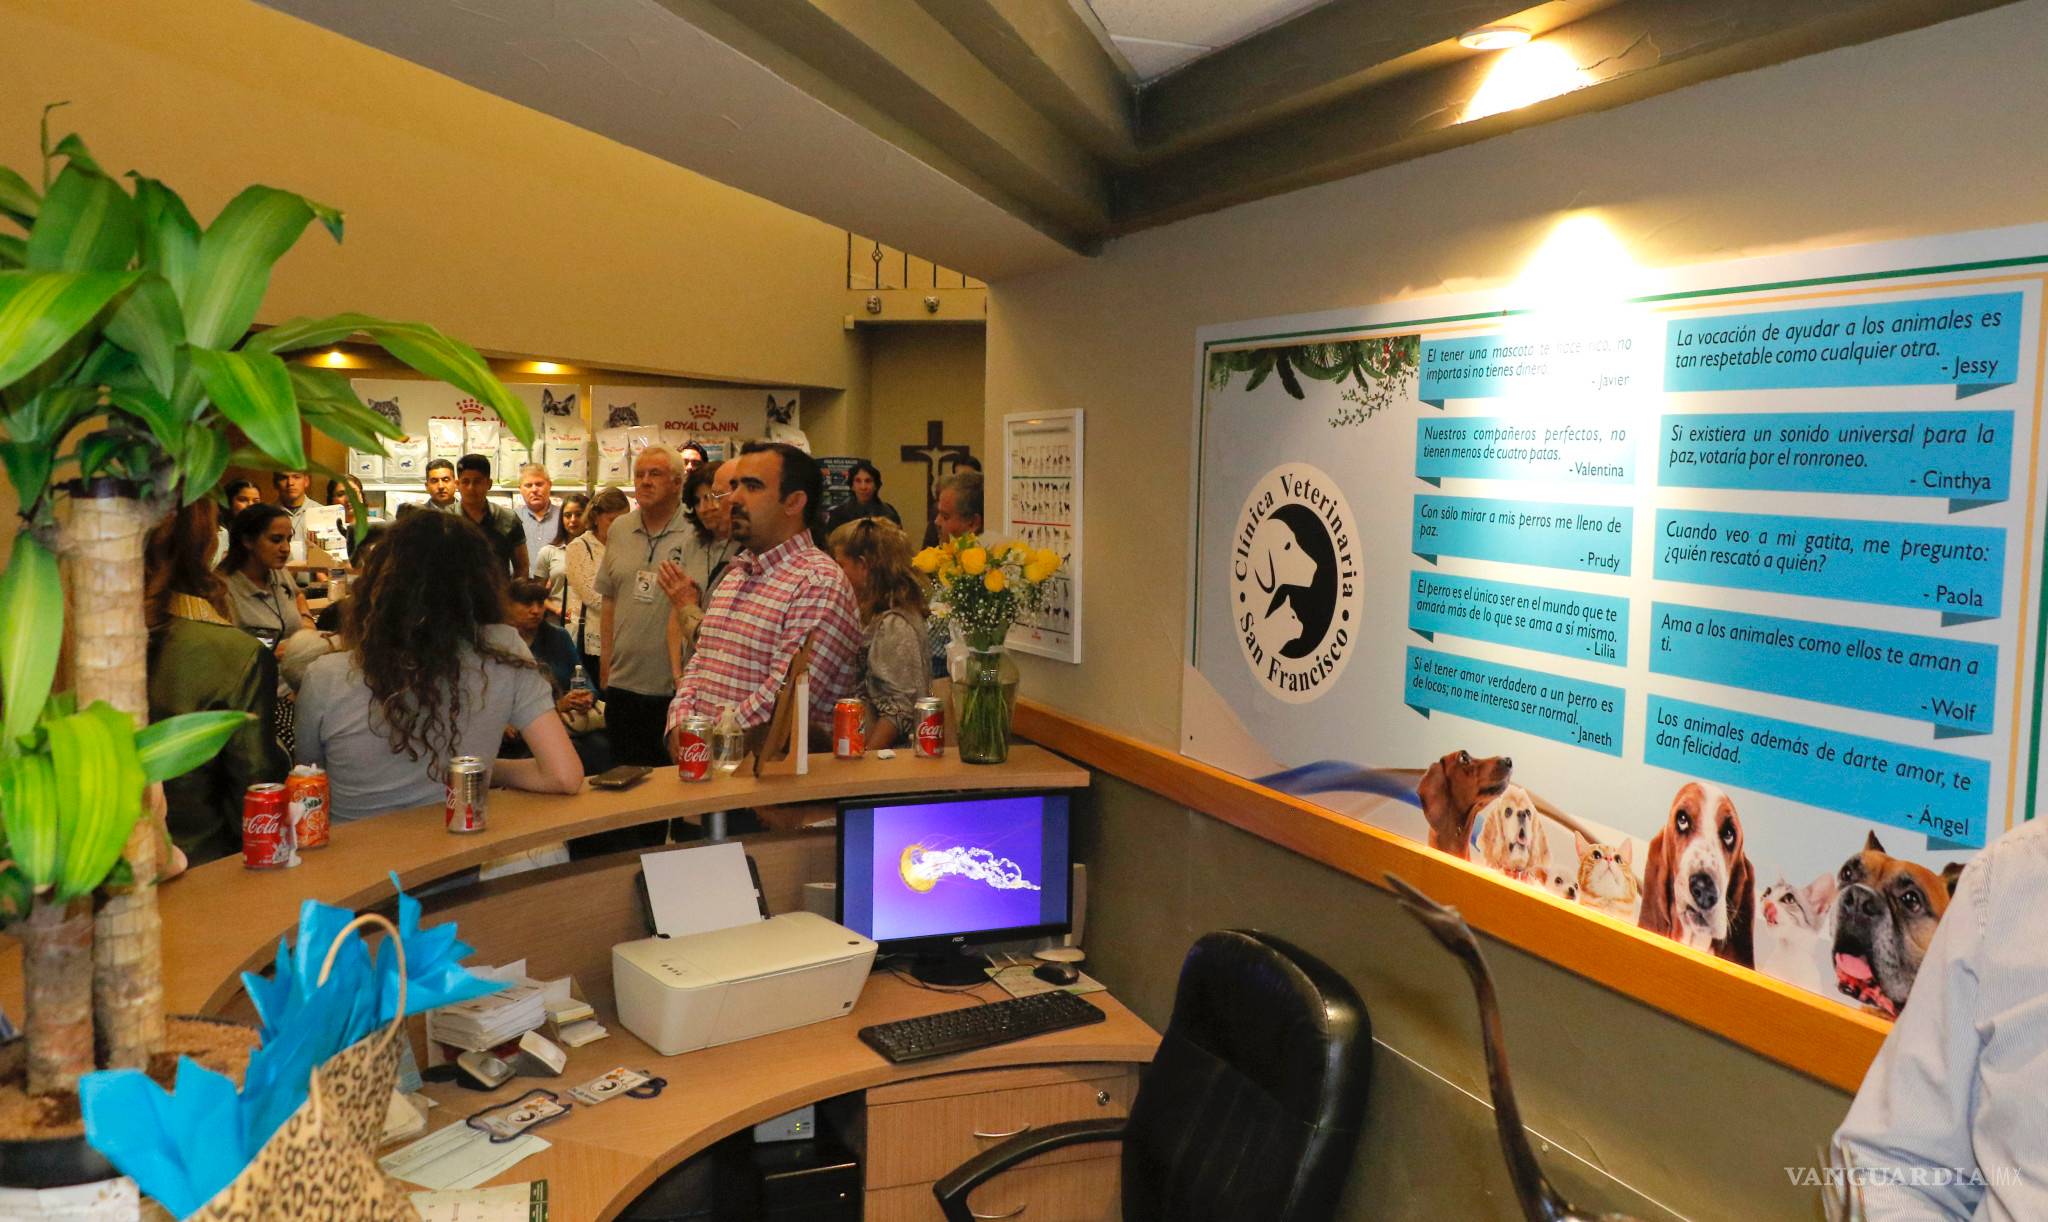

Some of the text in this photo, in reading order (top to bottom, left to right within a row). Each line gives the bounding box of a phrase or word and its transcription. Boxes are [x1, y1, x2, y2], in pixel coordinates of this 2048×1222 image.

[1678, 309, 2002, 347] La vocación de ayudar a los animales es
[1428, 348, 1436, 362] El
[1441, 349, 1464, 362] tener
[1470, 347, 1487, 360] una
[1493, 344, 1534, 358] mascota
[1617, 336, 1631, 350] no
[1676, 340, 1939, 369] tan respetable como cualquier otra.
[1427, 365, 1461, 384] importa
[1464, 364, 1470, 378] si
[1472, 366, 1483, 377] no
[1487, 361, 1513, 377] tienes
[1953, 356, 1998, 380] Jessy
[665, 421, 738, 432] ROYAL CANIN
[1425, 425, 1625, 444] Nuestros compañeros perfectos, no
[1671, 424, 1994, 448] Si existiera un sonido universal para la
[1424, 444, 1560, 462] tienen menos de cuatro patas.
[1670, 448, 1867, 469] paz, votaría por el ronroneo.
[1575, 464, 1624, 477] Valentina
[1923, 470, 1991, 494] Cinthya
[1420, 525, 1438, 538] paz.
[1421, 505, 1621, 533] Con sólo mirar a mis perros me lleno de
[1235, 473, 1357, 598] Clínica Veterinaria
[1667, 521, 1989, 563] Cuando veo a mi gatita, me pregunto:
[1588, 552, 1620, 571] Prudy
[1665, 543, 1827, 574] ¿quién rescató a quién?
[1418, 580, 1617, 622] El perro es el único ser en el mundo que te
[1936, 585, 1983, 607] Paola
[1417, 600, 1617, 642] amará más de lo que se ama a sí mismo.
[1240, 612, 1348, 691] San Francisco
[1594, 642, 1615, 659] Lilia
[1661, 635, 1672, 652] ti.
[1662, 614, 1978, 674] Ama a los animales como ellos te aman a
[1414, 657, 1613, 712] Si el tener amor verdadero a un perro es
[1413, 676, 1579, 725] de locos; no me interesa ser normal.
[1931, 697, 1977, 722] Wolf
[1578, 725, 1612, 747] Janeth
[1656, 731, 1741, 764] dan felicidad.
[1657, 708, 1971, 790] Los animales además de darte amor, te
[1919, 809, 1968, 837] Ángel
